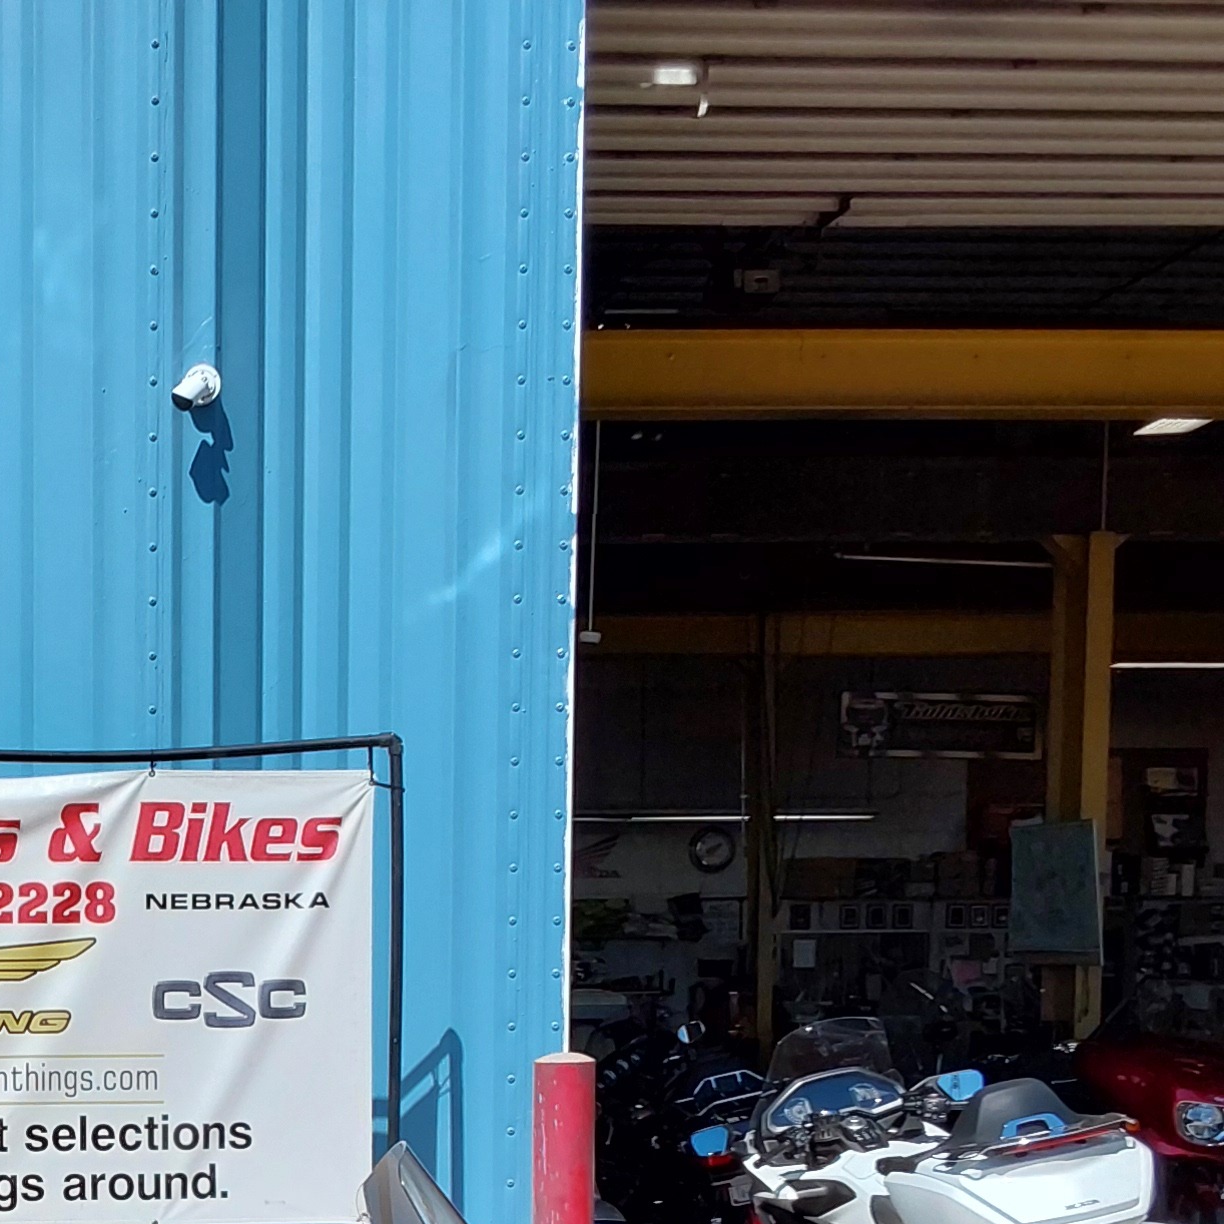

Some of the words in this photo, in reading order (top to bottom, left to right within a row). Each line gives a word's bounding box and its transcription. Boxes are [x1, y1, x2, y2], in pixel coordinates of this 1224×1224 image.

[47, 801, 103, 863] &
[129, 801, 343, 863] Bikes
[145, 892, 330, 910] NEBRASKA
[24, 1114, 253, 1153] selections
[62, 1163, 229, 1201] around.
